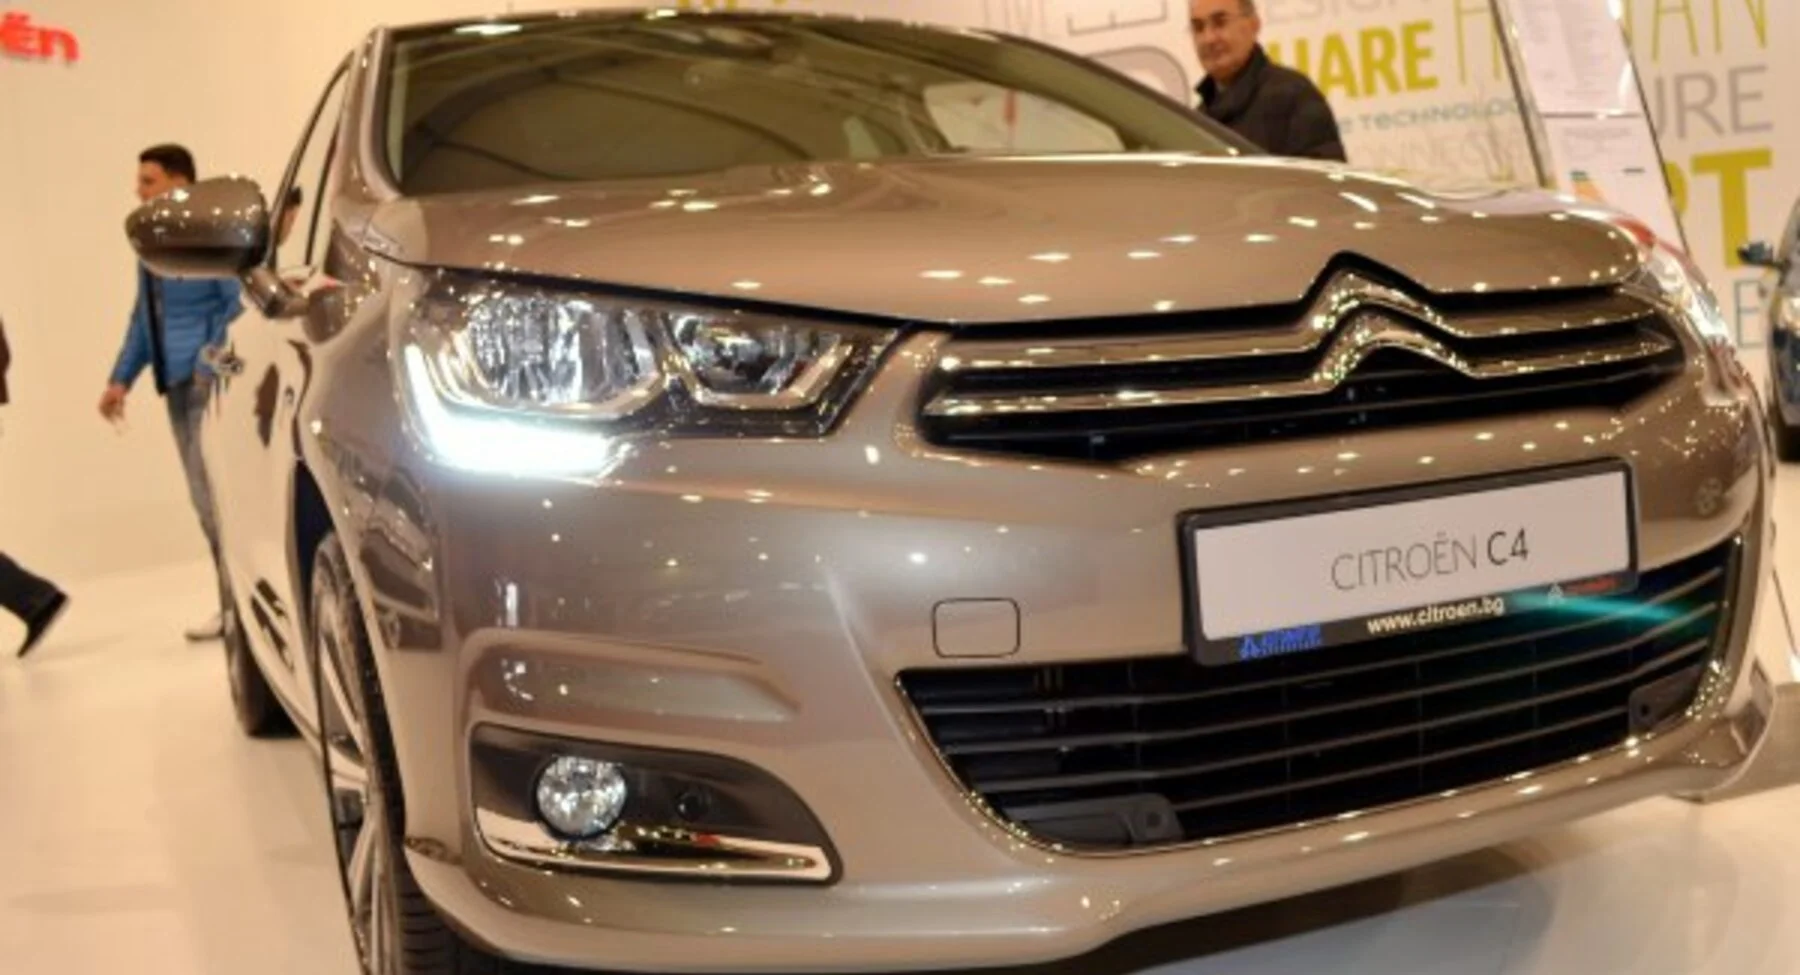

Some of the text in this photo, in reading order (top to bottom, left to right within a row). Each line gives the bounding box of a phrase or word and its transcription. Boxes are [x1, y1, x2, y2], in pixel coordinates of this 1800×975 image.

[1331, 528, 1529, 590] CITROËN C4
[1366, 597, 1506, 635] www.citroen.bg
